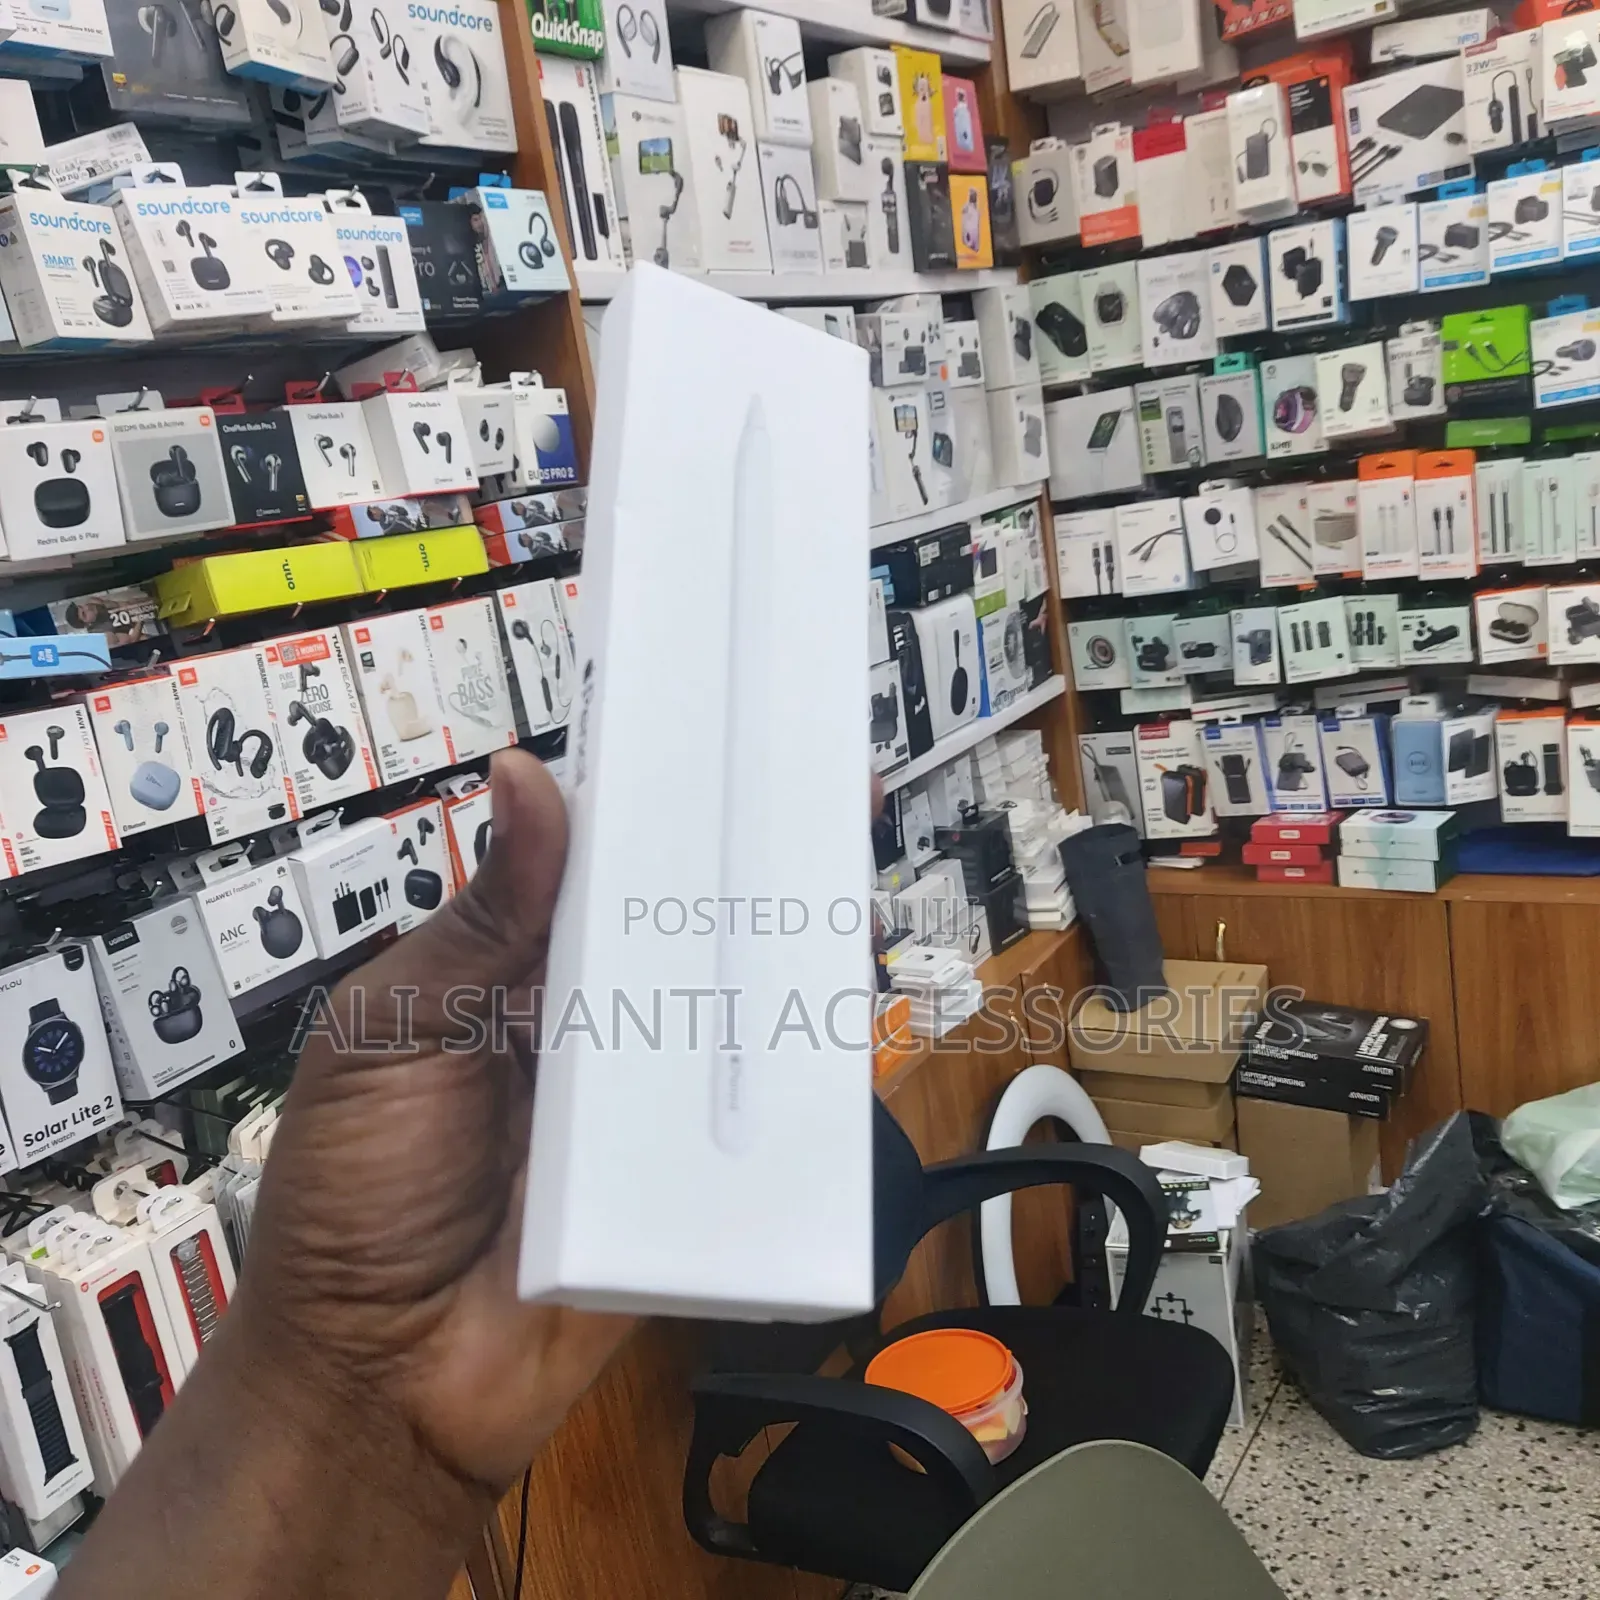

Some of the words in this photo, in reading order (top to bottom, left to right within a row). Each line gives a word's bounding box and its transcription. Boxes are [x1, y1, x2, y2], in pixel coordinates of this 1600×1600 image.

[408, 3, 493, 33] soundcore
[531, 12, 604, 54] QuickSnap
[1466, 60, 1491, 72] 33W
[137, 197, 231, 216] soundcore
[241, 205, 323, 224] soundcore
[30, 212, 112, 234] soundcore
[336, 225, 403, 242] soundcore
[42, 254, 75, 267] SMART
[114, 424, 138, 433] REDMI
[139, 422, 156, 430] Buds
[164, 419, 185, 428] Active
[223, 424, 247, 433] OnePlus
[247, 423, 261, 432] Buds
[261, 422, 272, 430] Pro
[528, 469, 549, 480] BUDS
[550, 468, 567, 479] PRO
[568, 467, 575, 478] 2
[37, 537, 58, 546] Redmi
[60, 535, 77, 543] Buds
[85, 531, 99, 541] Play
[419, 543, 430, 572] onn.
[282, 559, 296, 590] onn.
[110, 611, 131, 627] 20
[256, 653, 268, 689] ENDURANCE
[332, 634, 345, 664] TUNE
[340, 667, 353, 699] BEAM
[457, 677, 495, 707] BASS
[309, 700, 333, 715] NOISE
[76, 710, 86, 730] WAVE
[340, 855, 355, 866] Power
[205, 890, 233, 905] HUAWEI
[233, 881, 257, 894] FreeBuds
[109, 932, 133, 947] UGREEN
[220, 923, 247, 945] ANC
[1362, 1064, 1394, 1076] ANKER
[1349, 1091, 1380, 1103] ANKER
[23, 1118, 68, 1147] Solar
[72, 1104, 101, 1125] Lite
[104, 1095, 114, 1110] 2
[26, 1143, 50, 1158] Smart
[51, 1131, 76, 1146] Watch
